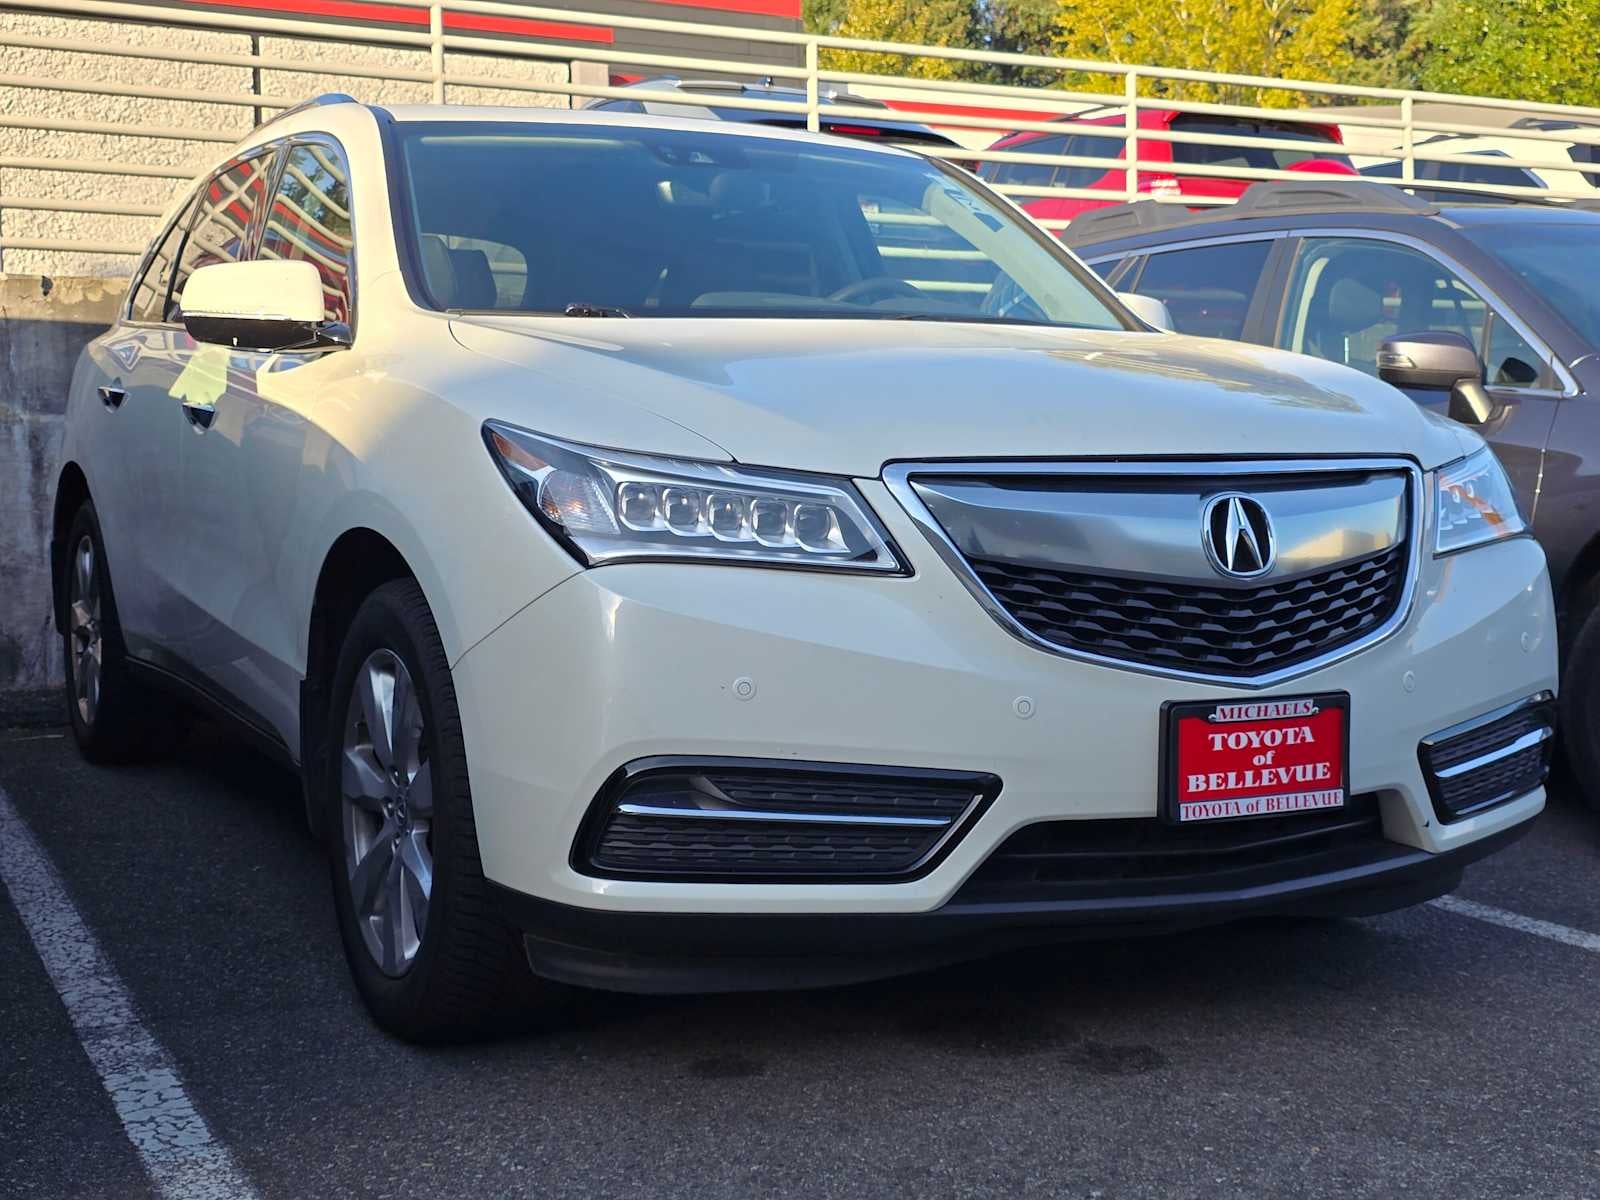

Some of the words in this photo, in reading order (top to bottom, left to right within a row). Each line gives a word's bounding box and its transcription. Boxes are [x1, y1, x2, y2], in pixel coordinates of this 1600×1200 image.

[1218, 701, 1312, 721] MICHAELS
[1208, 726, 1314, 751] TOYOTA
[1252, 750, 1276, 767] of
[1186, 762, 1330, 792] BELLEVUE
[1182, 801, 1241, 820] TOYOTA
[1246, 800, 1260, 813] of
[1265, 791, 1342, 808] BELLEVUE
